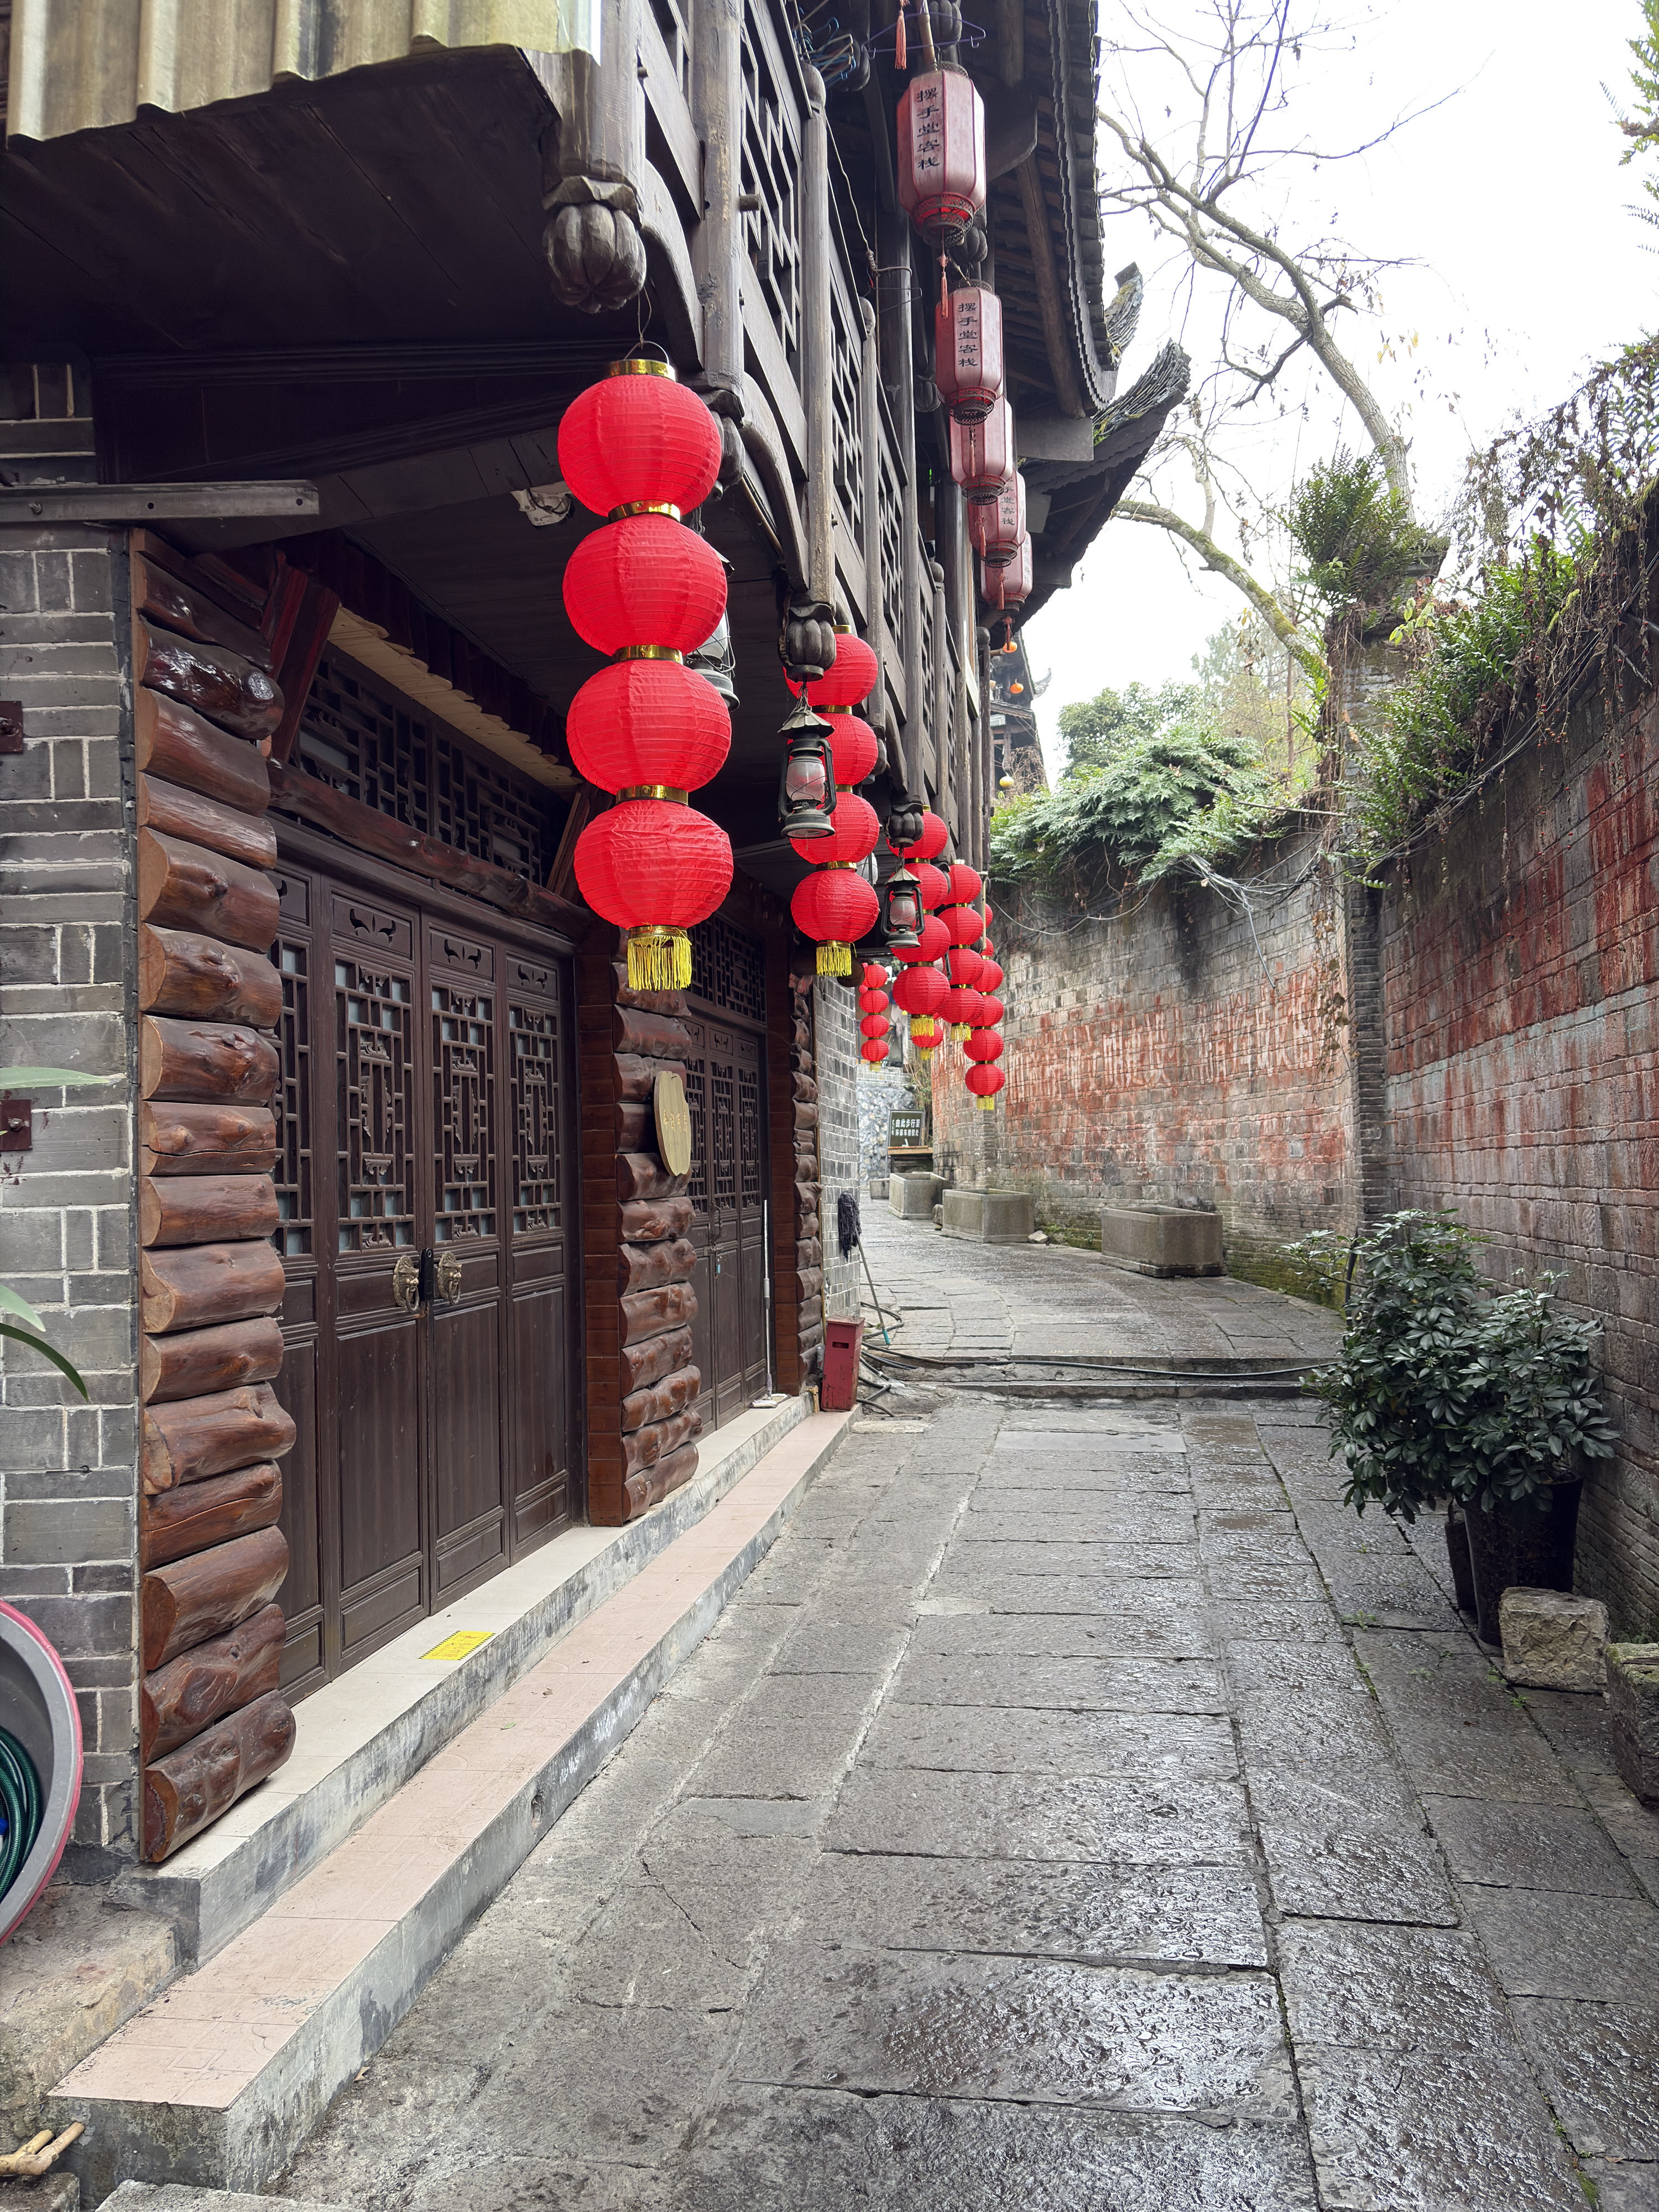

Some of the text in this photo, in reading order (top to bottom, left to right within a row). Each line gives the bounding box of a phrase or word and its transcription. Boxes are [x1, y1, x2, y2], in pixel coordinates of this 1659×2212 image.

[916, 87, 940, 170] 摆手堂客栈
[958, 302, 978, 367] 摆手堂客栈
[895, 1118, 921, 1128] 由此步行至
